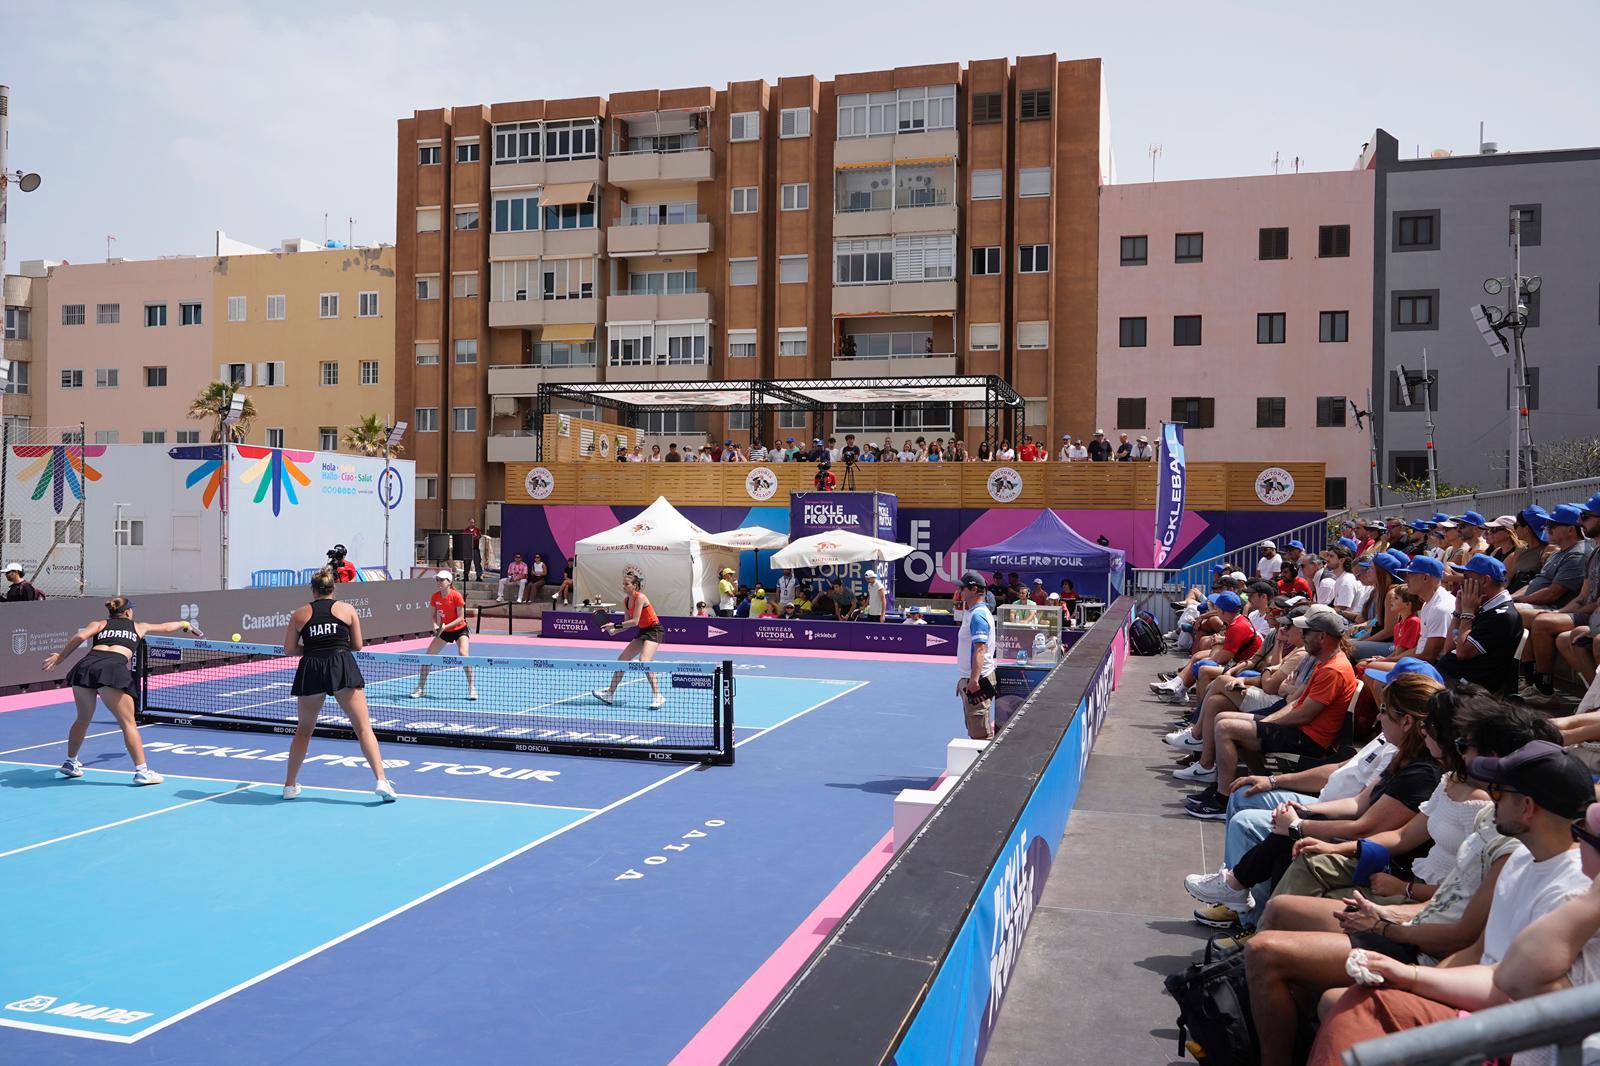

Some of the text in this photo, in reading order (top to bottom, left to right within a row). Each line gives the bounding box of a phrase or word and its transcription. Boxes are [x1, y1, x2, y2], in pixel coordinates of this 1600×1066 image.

[322, 463, 336, 471] Hola
[804, 504, 844, 515] PICKLE
[596, 543, 669, 552] CERVEZAS VICTORIA
[395, 601, 432, 612] VOLV
[242, 610, 295, 631] Canarias
[308, 622, 339, 638] HART
[553, 623, 589, 631] VICTORIA
[97, 629, 138, 643] MORRIS
[755, 631, 794, 639] VICTORIA
[174, 717, 193, 725] nox
[396, 735, 418, 743] nox
[528, 744, 551, 752] OFICIAL
[648, 752, 673, 760] nox
[142, 741, 292, 762] PICKLE
[415, 761, 561, 783] TOUR
[614, 819, 726, 882] VOLVO
[991, 828, 1027, 959] PICKLE
